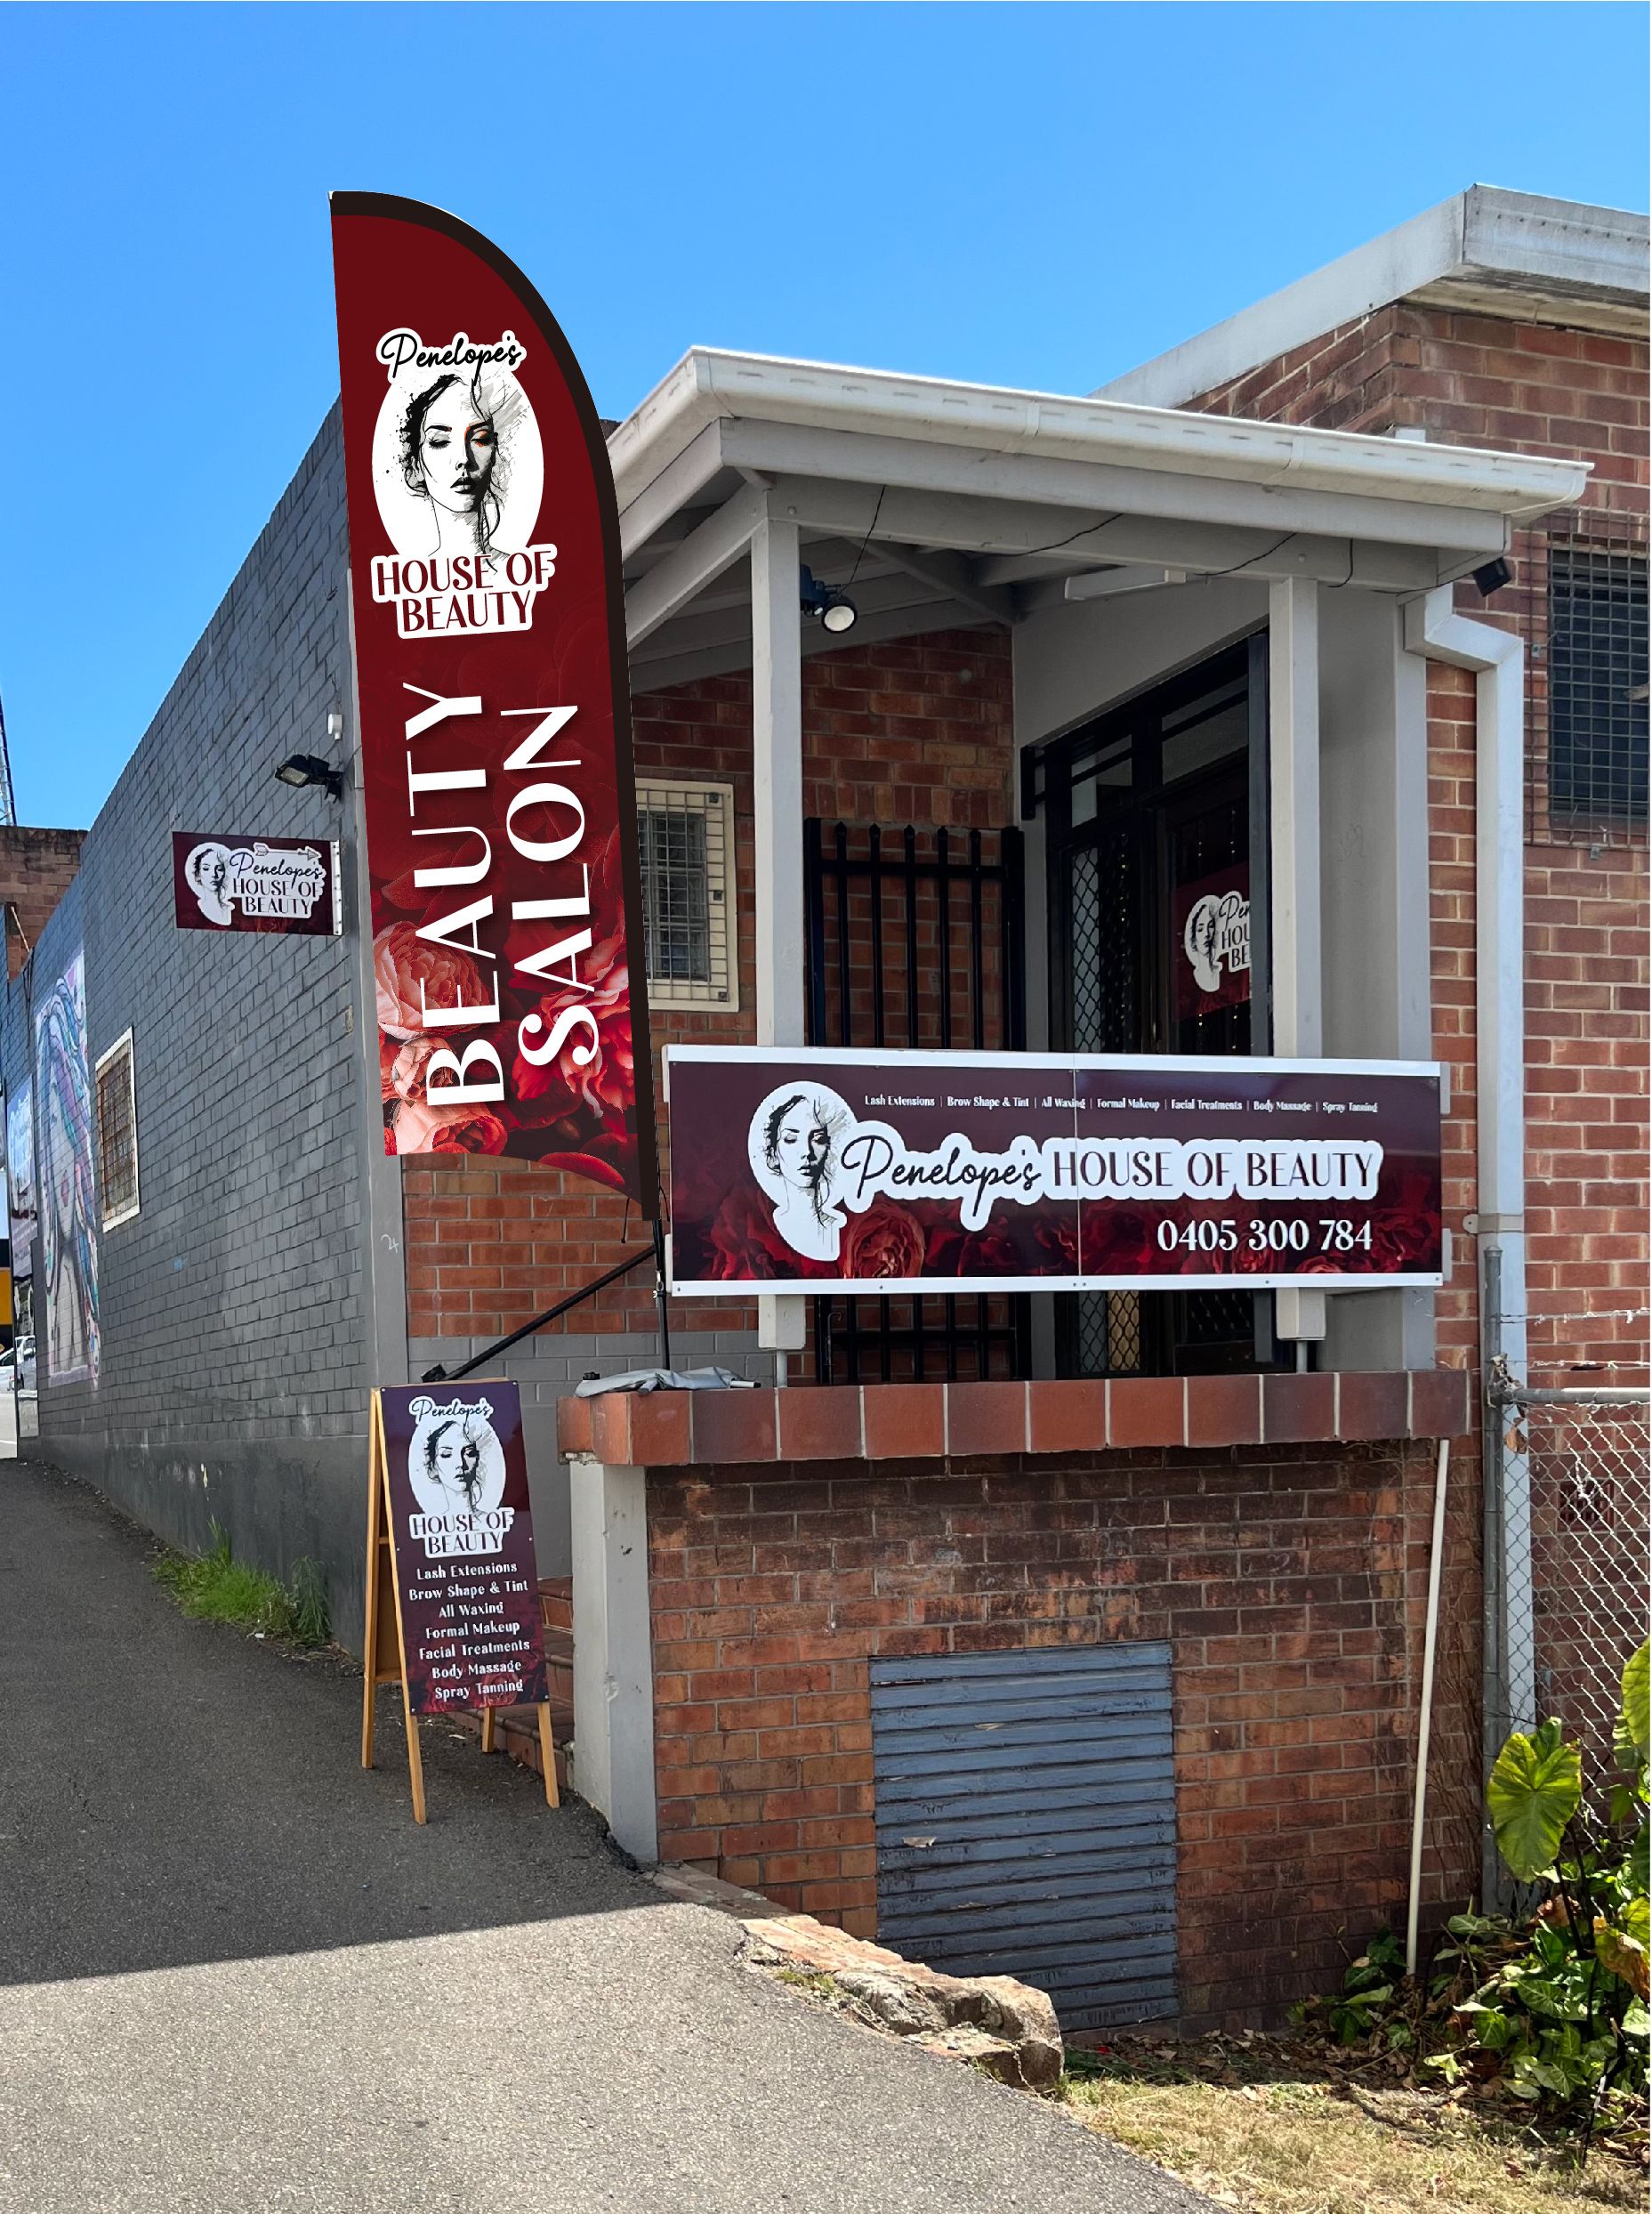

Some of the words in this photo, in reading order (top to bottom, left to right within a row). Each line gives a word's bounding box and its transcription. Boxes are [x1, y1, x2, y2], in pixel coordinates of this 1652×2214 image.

[380, 332, 522, 386] Penelope's
[376, 554, 493, 596] HOUSE
[505, 550, 552, 586] OF
[401, 589, 531, 633] BEAUTY
[230, 851, 324, 889] Penelope's
[233, 877, 292, 897] HOUSE
[298, 881, 320, 898] OF
[402, 682, 505, 1106] BEAUTY
[500, 705, 600, 1066] SALON
[246, 896, 311, 915] BEAUTY
[865, 1094, 886, 1106] Lash
[888, 1095, 935, 1107] Extensions
[947, 1095, 971, 1107] Brow
[973, 1096, 1000, 1110] Shape
[1002, 1096, 1011, 1107] &
[1012, 1096, 1029, 1107] Tint
[1042, 1096, 1052, 1108] All
[1055, 1097, 1086, 1110] Waxing
[1097, 1097, 1126, 1109] Formal
[1128, 1097, 1160, 1111] Makeup
[1171, 1099, 1196, 1110] Facial
[1197, 1099, 1243, 1111] Treatments
[1253, 1100, 1275, 1113] Body
[1276, 1101, 1311, 1112] Massage
[1322, 1102, 1345, 1114] Spray
[1349, 1102, 1378, 1113] Tanning
[841, 1135, 1042, 1217] Penelope's
[1053, 1151, 1173, 1187] HOUSE
[1188, 1152, 1233, 1187] OF
[1247, 1152, 1373, 1187] BEAUTY
[1157, 1219, 1238, 1251] 0405
[1248, 1219, 1310, 1251] 300
[1318, 1219, 1373, 1251] 784
[411, 1399, 489, 1422] Penelope's
[412, 1514, 480, 1536] HOUSE
[486, 1510, 513, 1530] OF
[427, 1531, 501, 1555] BEAUTY
[416, 1564, 447, 1580] Lash
[450, 1562, 518, 1578] Extensions
[408, 1588, 443, 1601] Brow
[447, 1583, 486, 1599] Shape
[489, 1581, 501, 1594] &
[504, 1580, 528, 1592] Tint
[439, 1604, 455, 1619] All
[458, 1601, 504, 1616] Waxing
[425, 1622, 469, 1639] Formal
[472, 1620, 520, 1636] Makeup
[419, 1644, 455, 1660] Facial
[460, 1639, 530, 1657] Treatments
[431, 1663, 463, 1679] Body
[468, 1660, 522, 1677] Massage
[434, 1685, 471, 1702] Spray
[475, 1678, 524, 1695] Tanning
